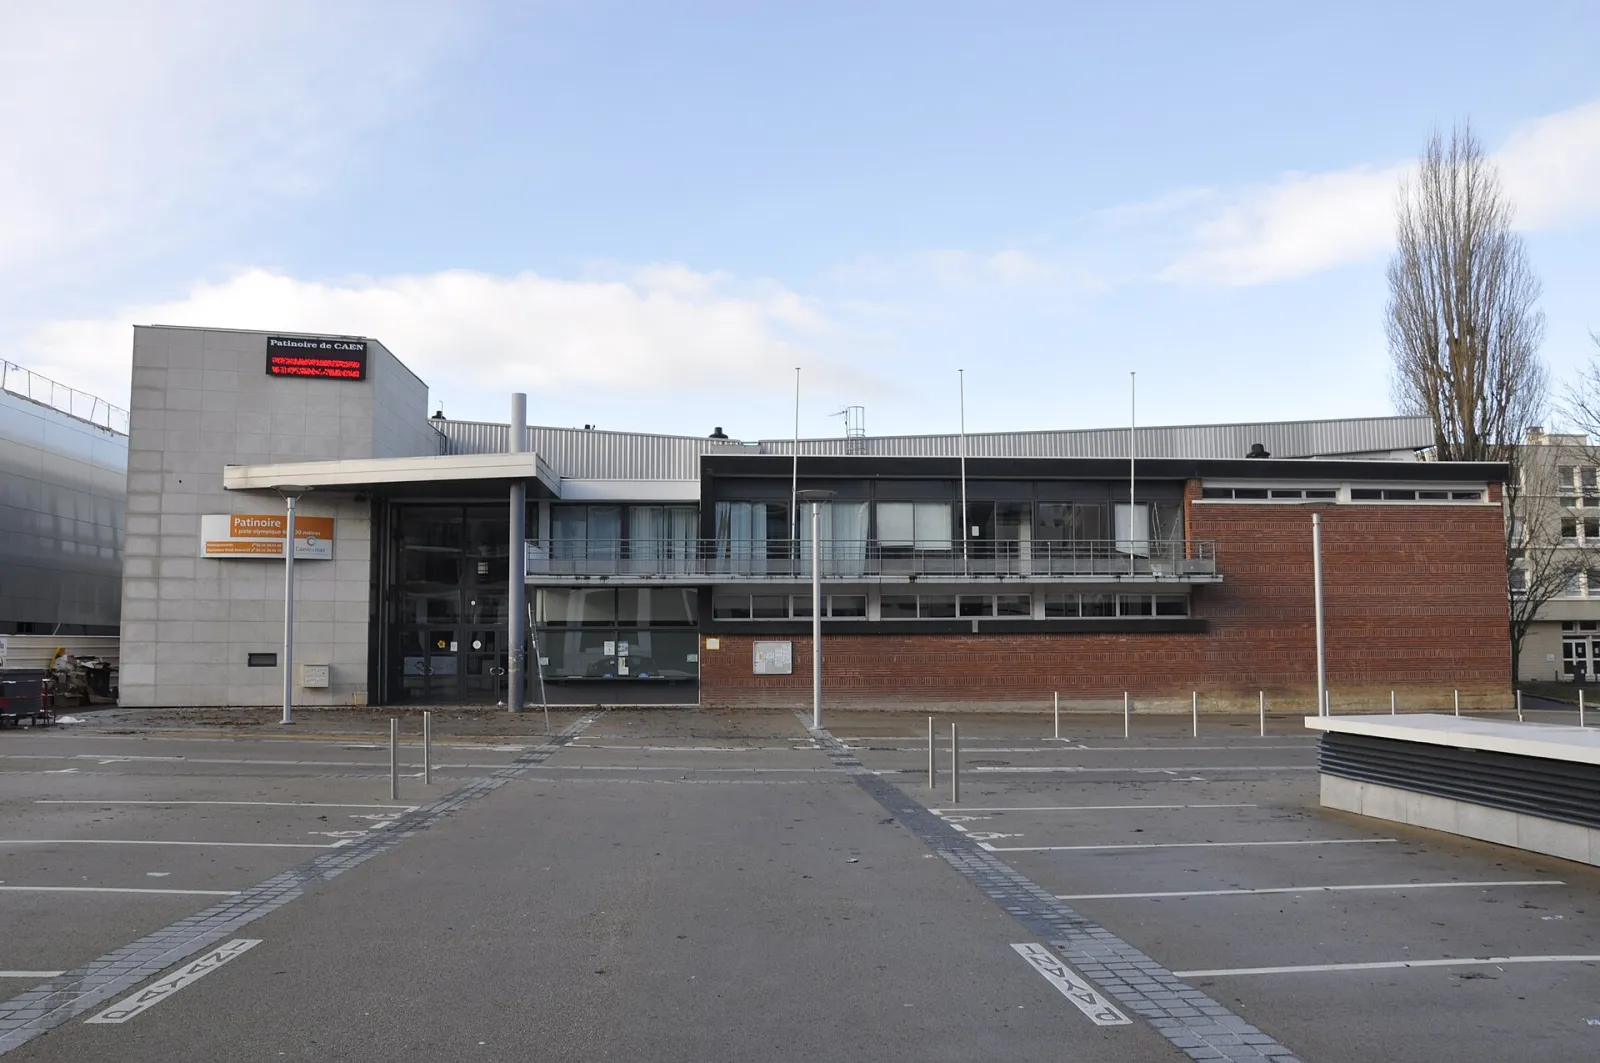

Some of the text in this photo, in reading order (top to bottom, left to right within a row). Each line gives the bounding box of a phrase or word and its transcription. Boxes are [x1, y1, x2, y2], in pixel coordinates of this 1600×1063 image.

[270, 339, 317, 349] Patinoire
[334, 343, 365, 351] CAEN
[234, 517, 281, 528] Patinoire
[102, 941, 246, 1019] PAYANT
[1025, 945, 1123, 1021] PAYANT
